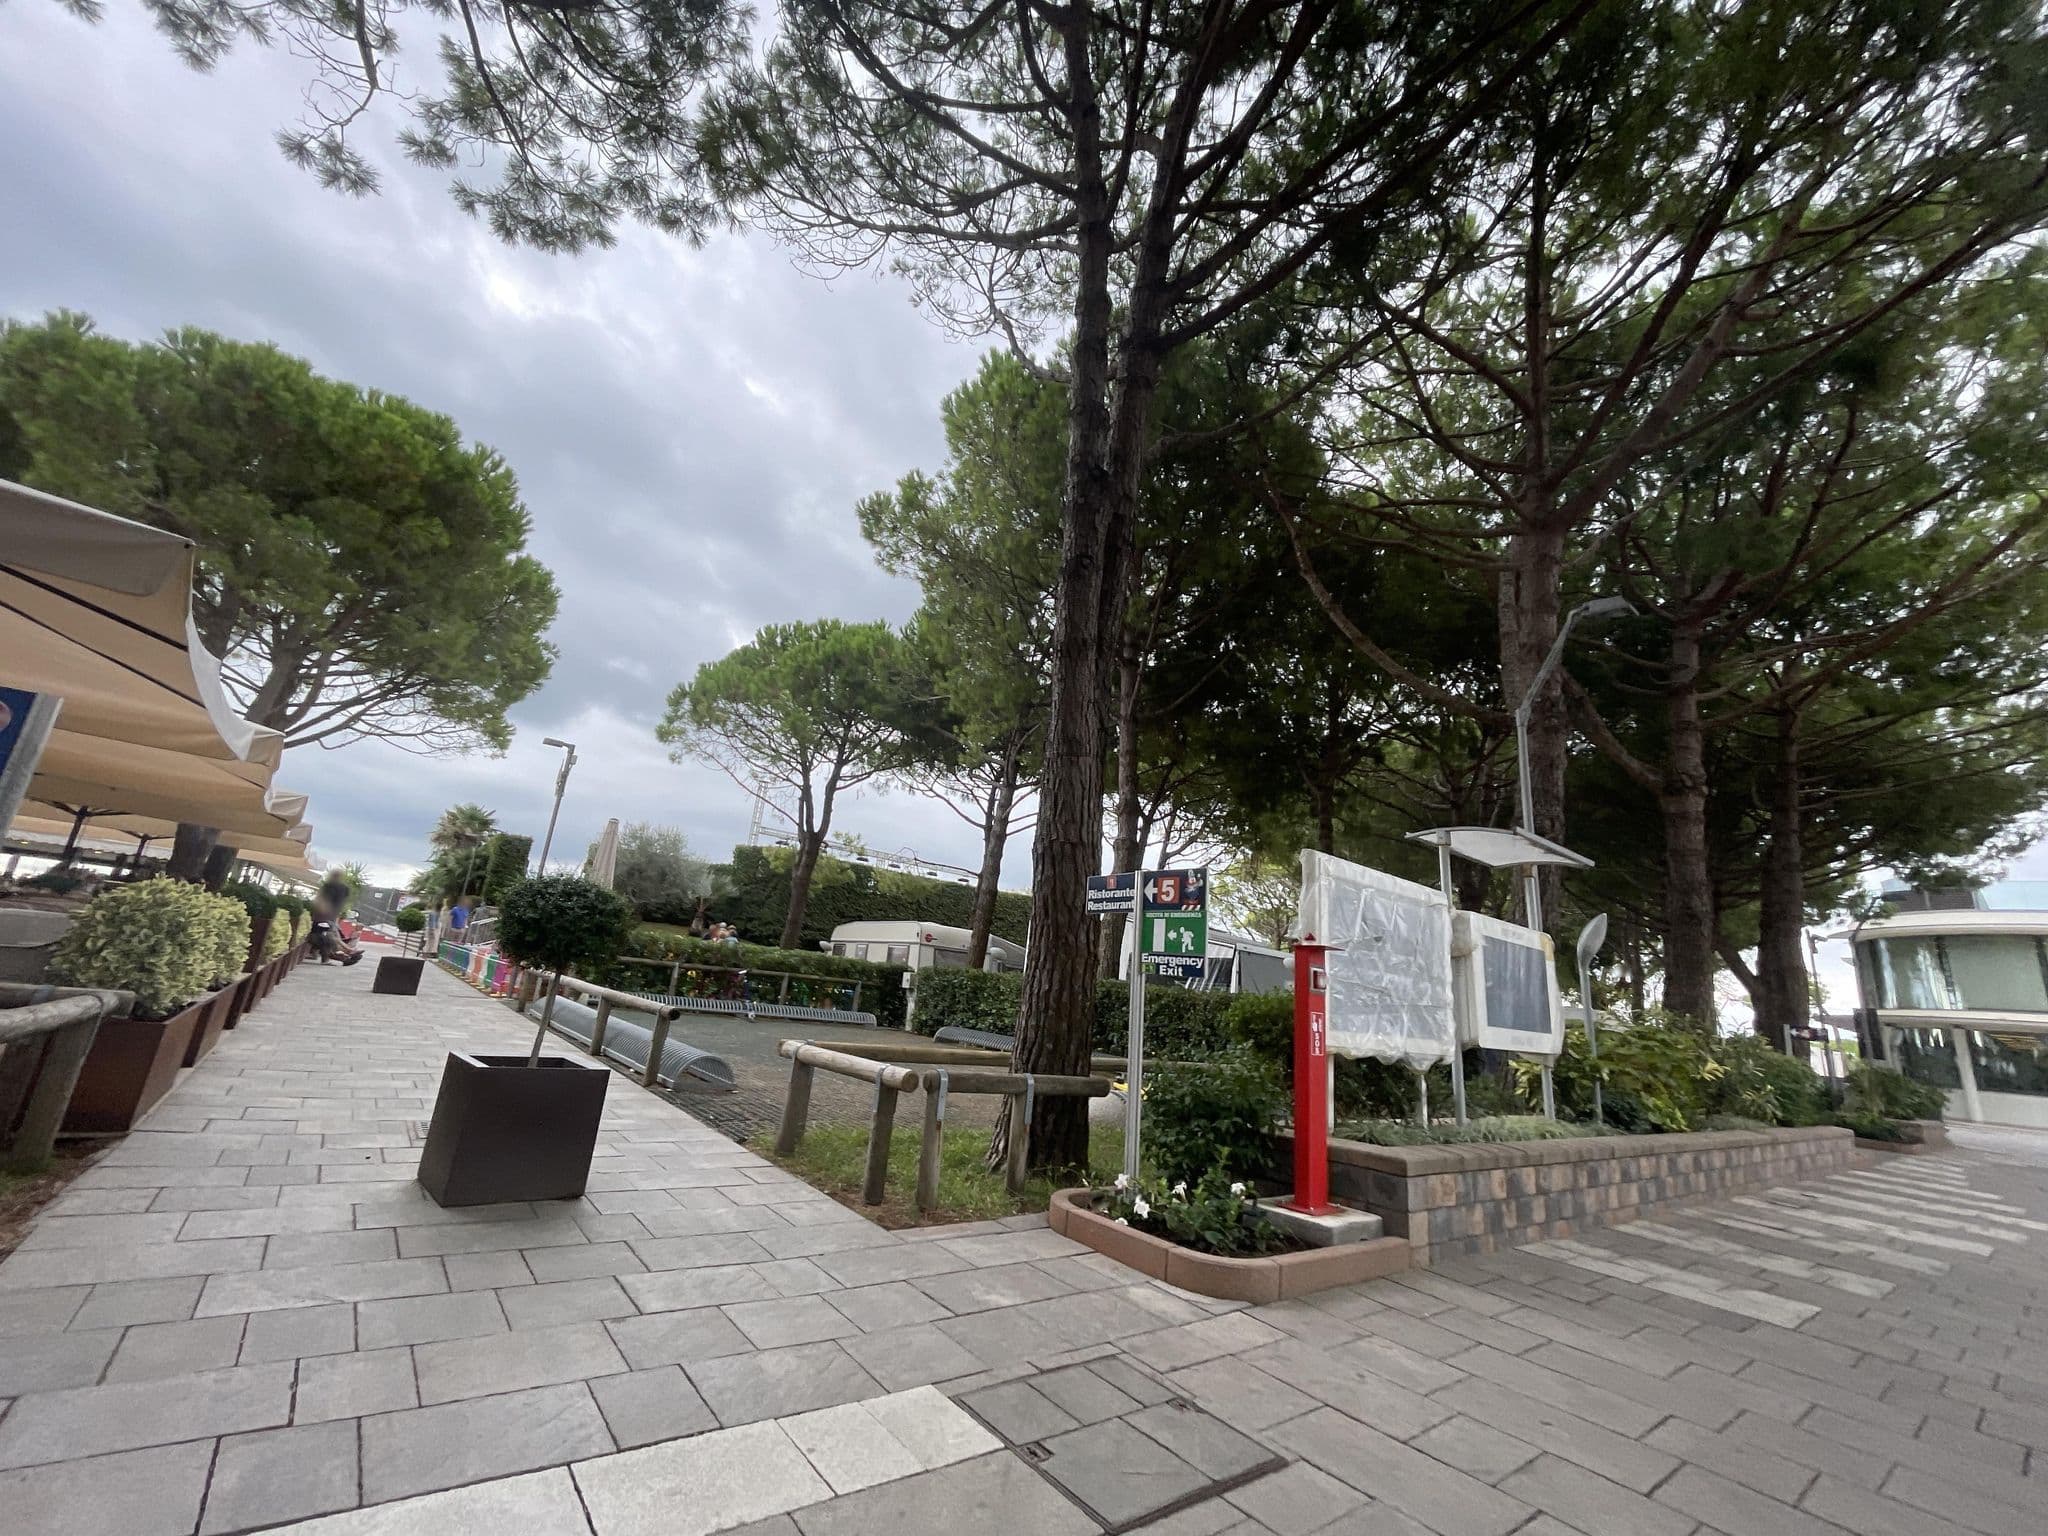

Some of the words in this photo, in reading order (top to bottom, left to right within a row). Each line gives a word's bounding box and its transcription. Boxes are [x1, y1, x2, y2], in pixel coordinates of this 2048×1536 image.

[1088, 888, 1136, 899] Ristorante
[1161, 880, 1174, 901] 5
[1141, 953, 1203, 968] Emergency
[1159, 965, 1183, 976] Exit
